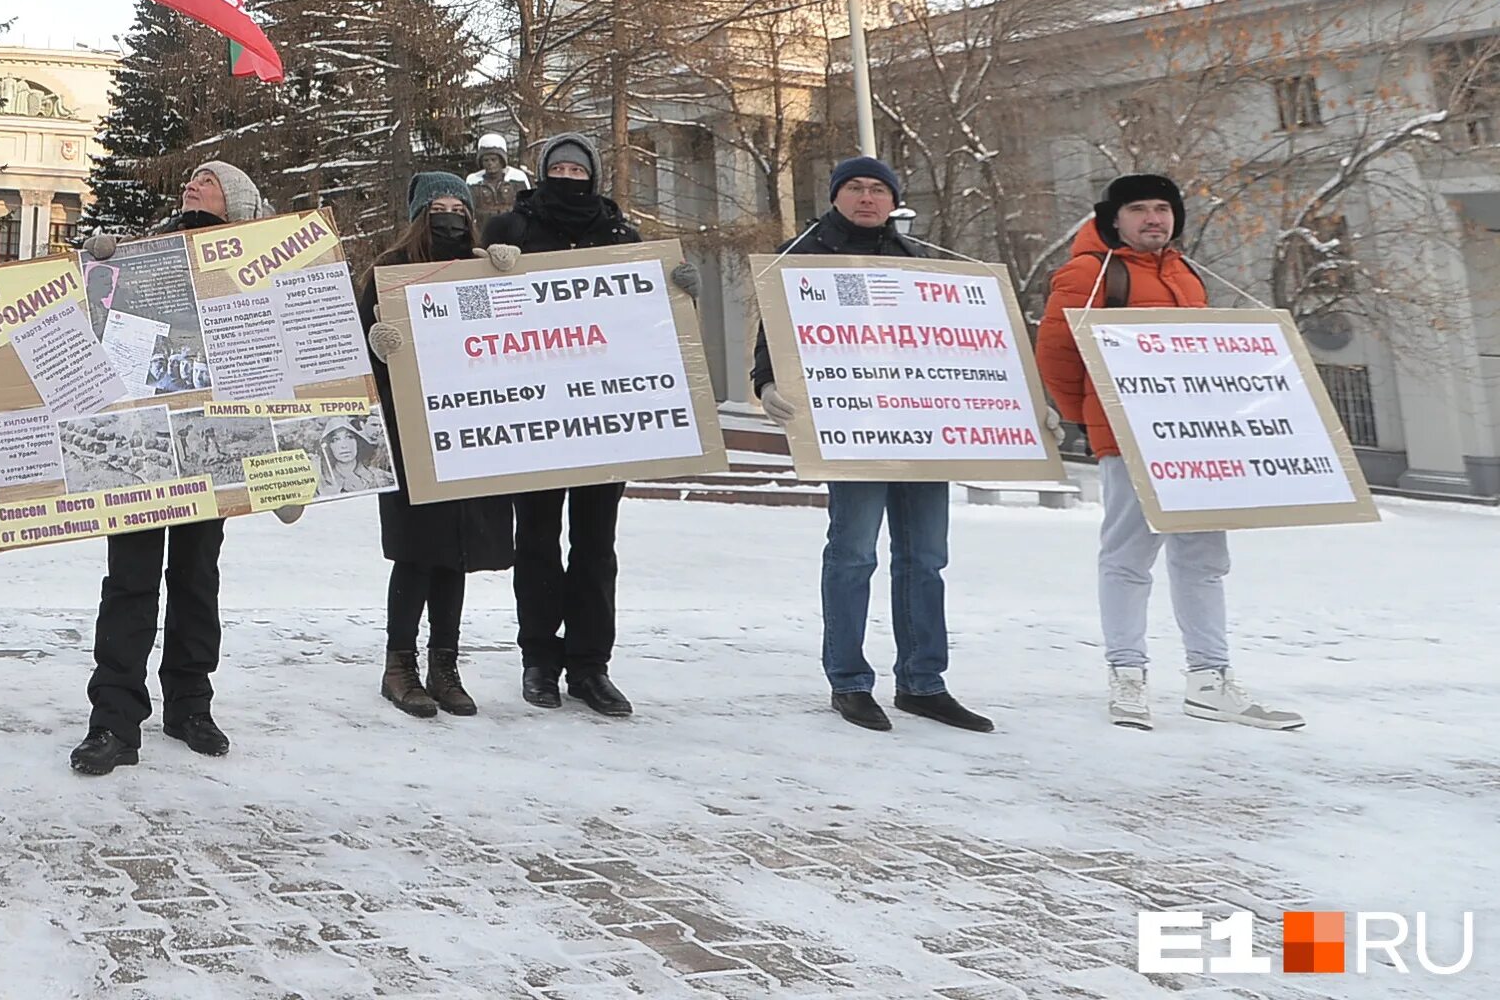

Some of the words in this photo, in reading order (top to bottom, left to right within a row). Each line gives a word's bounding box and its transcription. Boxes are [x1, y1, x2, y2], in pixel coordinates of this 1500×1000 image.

[201, 237, 244, 263] БЕЗ
[238, 221, 329, 287] СТАЛИНА
[282, 277, 305, 287] марта
[307, 272, 325, 282] 1953
[326, 270, 344, 280] года
[532, 272, 654, 304] УБРАТЬ
[286, 290, 306, 300] умер
[307, 283, 339, 295] Сталин.
[800, 286, 826, 301] Мы
[914, 281, 961, 304] ТРИ
[963, 285, 987, 306] !!!
[208, 303, 231, 313] марта
[232, 299, 250, 308] 1940
[251, 296, 270, 306] года
[422, 302, 448, 318] Мы
[14, 336, 21, 344] 5
[20, 324, 43, 341] марта
[41, 314, 59, 328] 1966
[58, 305, 76, 320] года
[204, 315, 233, 327] Сталин
[234, 309, 272, 322] подписал
[464, 323, 608, 358] СТАЛИНА
[797, 324, 1008, 351] КОМАНДУЮЩИХ
[1137, 333, 1166, 354] 65
[1170, 336, 1210, 354] ЛЕТ
[1213, 336, 1279, 356] НАЗАД
[805, 367, 848, 382] УрВО
[852, 367, 900, 380] БЫЛИ
[1115, 376, 1179, 395] КУЛЬТ
[1184, 375, 1291, 394] ЛИЧНОСТИ
[427, 384, 547, 411] БАРЕЛЬЕФУ
[567, 381, 595, 399] НЕ
[601, 374, 676, 396] МЕСТО
[209, 404, 250, 415] ПАМЯТЬ
[255, 404, 262, 414] О
[266, 403, 312, 414] ЖЕРТВАХ
[320, 401, 365, 413] ТЕРРОРА
[812, 397, 823, 409] В
[827, 397, 873, 411] ГОДЫ
[963, 398, 1021, 411] ТЕРРОРА
[3, 415, 49, 427] километр
[434, 431, 452, 452] В
[460, 407, 690, 449] ЕКАТЕРИНБУРГЕ
[1152, 419, 1247, 440] СТАЛИНА
[1248, 418, 1294, 438] БЫЛ
[820, 431, 847, 445] ПО
[853, 430, 933, 446] ПРИКАЗУ
[942, 427, 1037, 446] СТАЛИНА
[250, 455, 293, 468] Хранители
[295, 453, 306, 461] ее
[1150, 459, 1246, 482] ОСУЖДЕН
[1249, 456, 1335, 477] ТОЧКА!!!
[249, 470, 273, 480] снова
[275, 465, 311, 477] названы
[0, 503, 47, 521] Спасем
[56, 497, 95, 514] Место
[104, 488, 152, 508] Памяти
[156, 487, 165, 499] и
[170, 480, 208, 497] покоя
[1, 530, 15, 543] от
[108, 516, 117, 528] и
